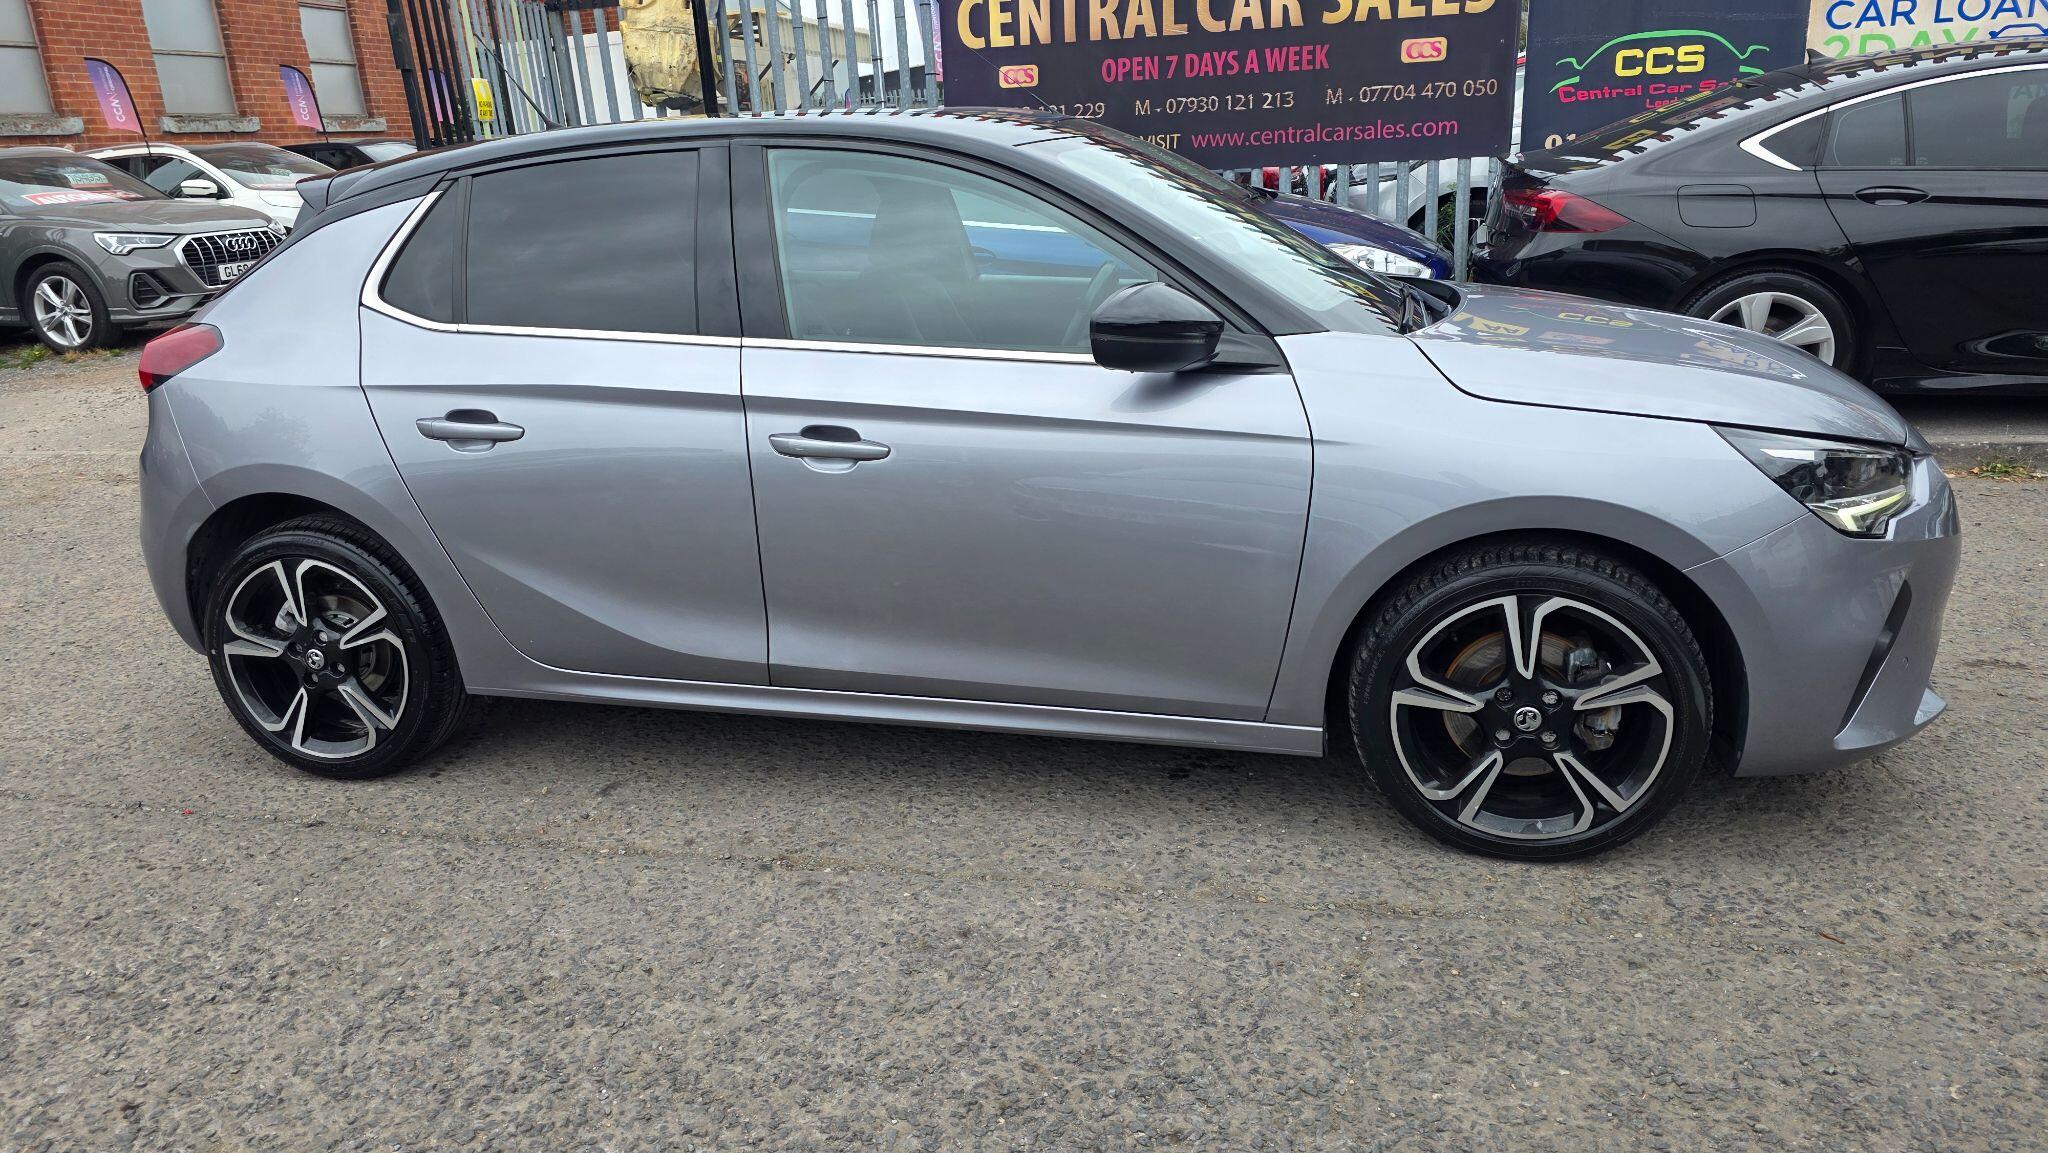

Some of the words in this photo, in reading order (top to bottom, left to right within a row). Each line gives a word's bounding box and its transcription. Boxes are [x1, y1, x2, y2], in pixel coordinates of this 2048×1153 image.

[957, 0, 1188, 50] CENTRAL
[1825, 0, 1916, 31] CAR
[1101, 56, 1159, 83] OPEN
[1165, 55, 1178, 79] 7
[1185, 51, 1239, 77] DAYS
[1245, 49, 1259, 74] A
[1265, 44, 1330, 72] WEEK
[1614, 44, 1705, 77] CCS
[1135, 100, 1151, 116] M
[1166, 96, 1219, 114] 07930
[1226, 94, 1253, 111] 121
[1263, 92, 1294, 109] 213
[1359, 83, 1415, 103] 07704
[1421, 81, 1457, 99] 470
[1463, 79, 1497, 97] 050
[1558, 85, 1642, 103] Central
[1649, 83, 1692, 95] Car
[1073, 102, 1105, 118] 229
[1191, 118, 1458, 149] www.centralcarsales.com
